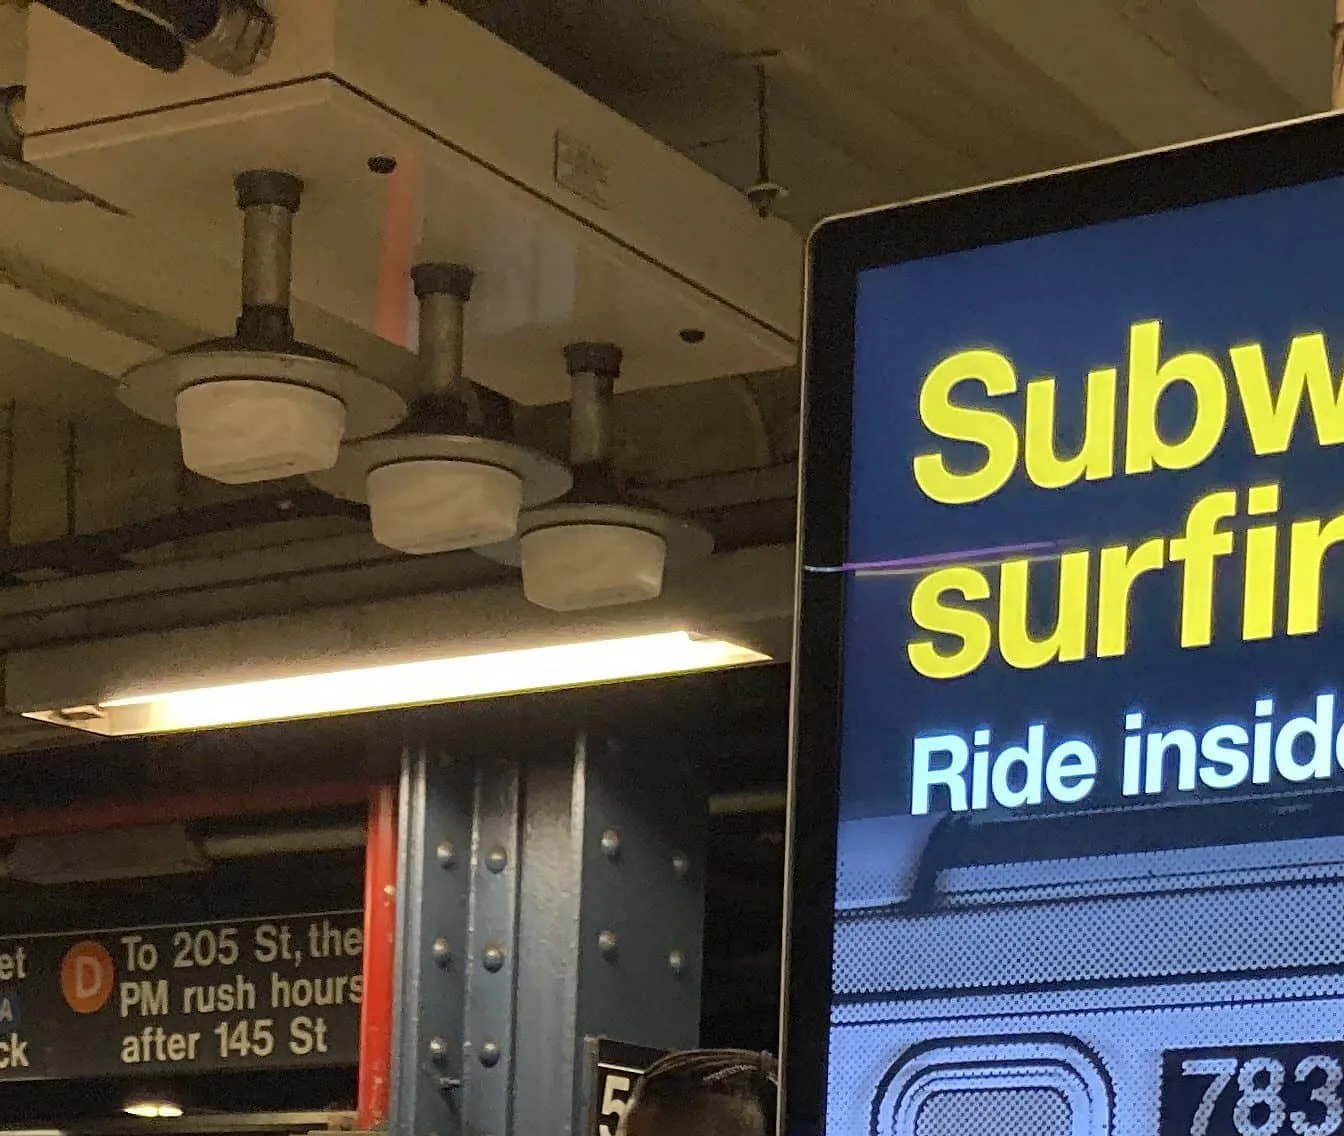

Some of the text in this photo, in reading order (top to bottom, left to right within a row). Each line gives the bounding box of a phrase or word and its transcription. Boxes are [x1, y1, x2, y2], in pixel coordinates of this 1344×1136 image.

[911, 723, 1096, 815] Ride
[121, 919, 364, 971] To 205 St, the
[76, 955, 102, 998] D
[120, 972, 364, 1018] PM rush hours
[121, 1016, 328, 1064] after 145 St
